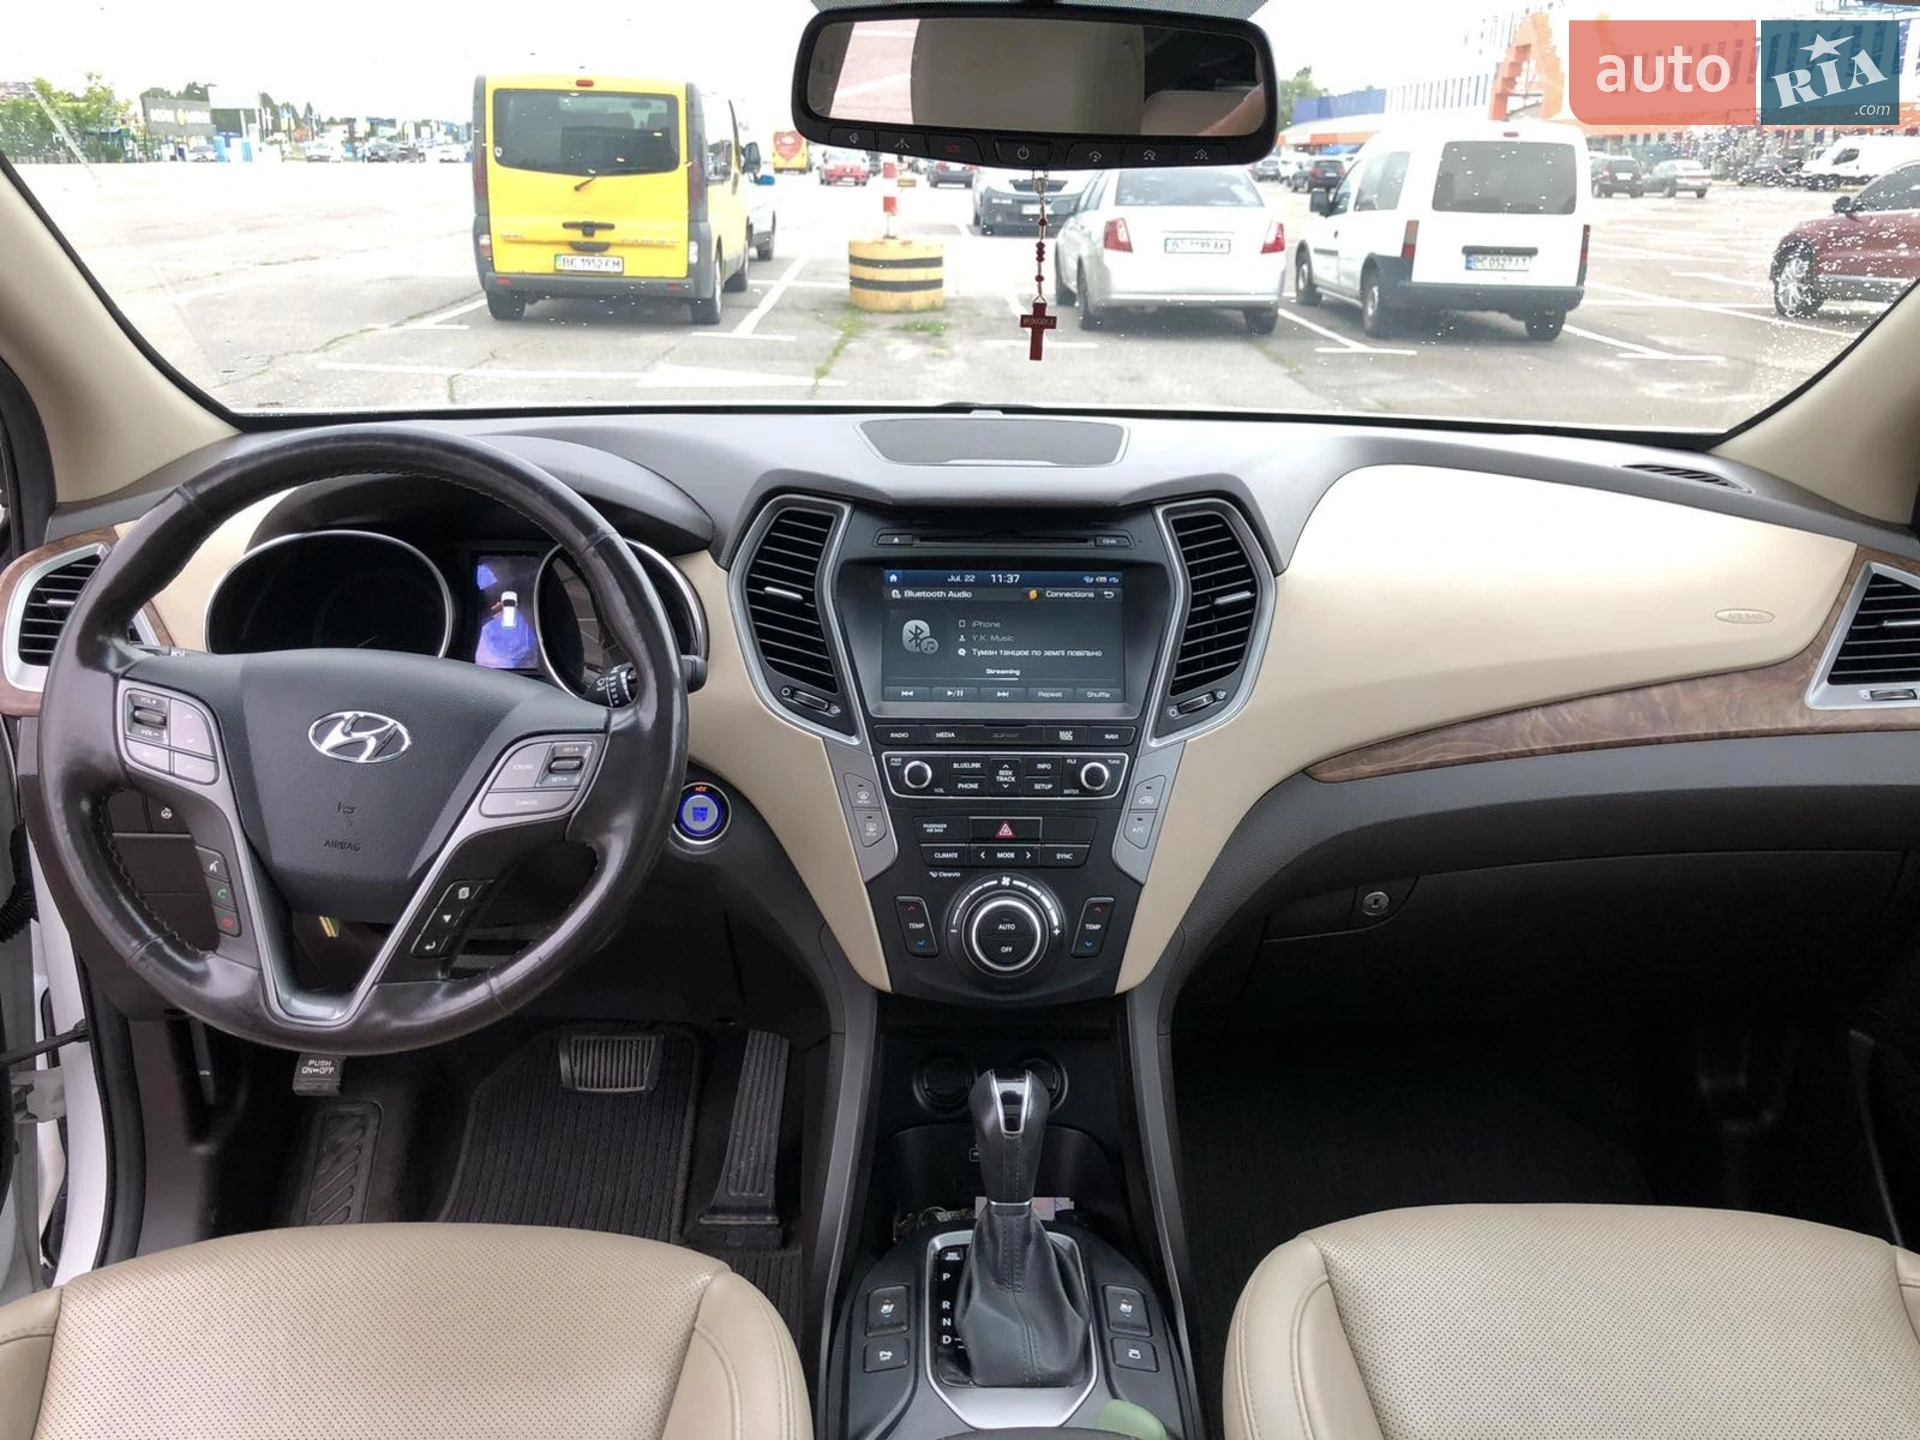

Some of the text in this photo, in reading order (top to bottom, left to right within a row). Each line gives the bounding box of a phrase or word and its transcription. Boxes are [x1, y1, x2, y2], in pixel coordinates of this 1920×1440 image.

[961, 574, 976, 583] 22
[990, 574, 1020, 584] 11:37
[904, 589, 972, 598] Bluetooth Audio
[1045, 590, 1094, 598] Connections
[972, 620, 1001, 629] iPhone
[990, 634, 1015, 642] Music
[972, 648, 998, 658] Туман
[1031, 649, 1042, 657] по
[1067, 648, 1102, 657] повільно
[986, 668, 1021, 676] Streaming
[1038, 690, 1063, 699] Repeat
[1086, 690, 1111, 698] Shuffle
[324, 840, 362, 851] AIRBAG
[308, 1059, 332, 1067] PUSH
[301, 1066, 335, 1074] ON OFF
[942, 1272, 951, 1281] P
[942, 1300, 951, 1310] R
[942, 1317, 951, 1327] N
[942, 1335, 952, 1345] D
